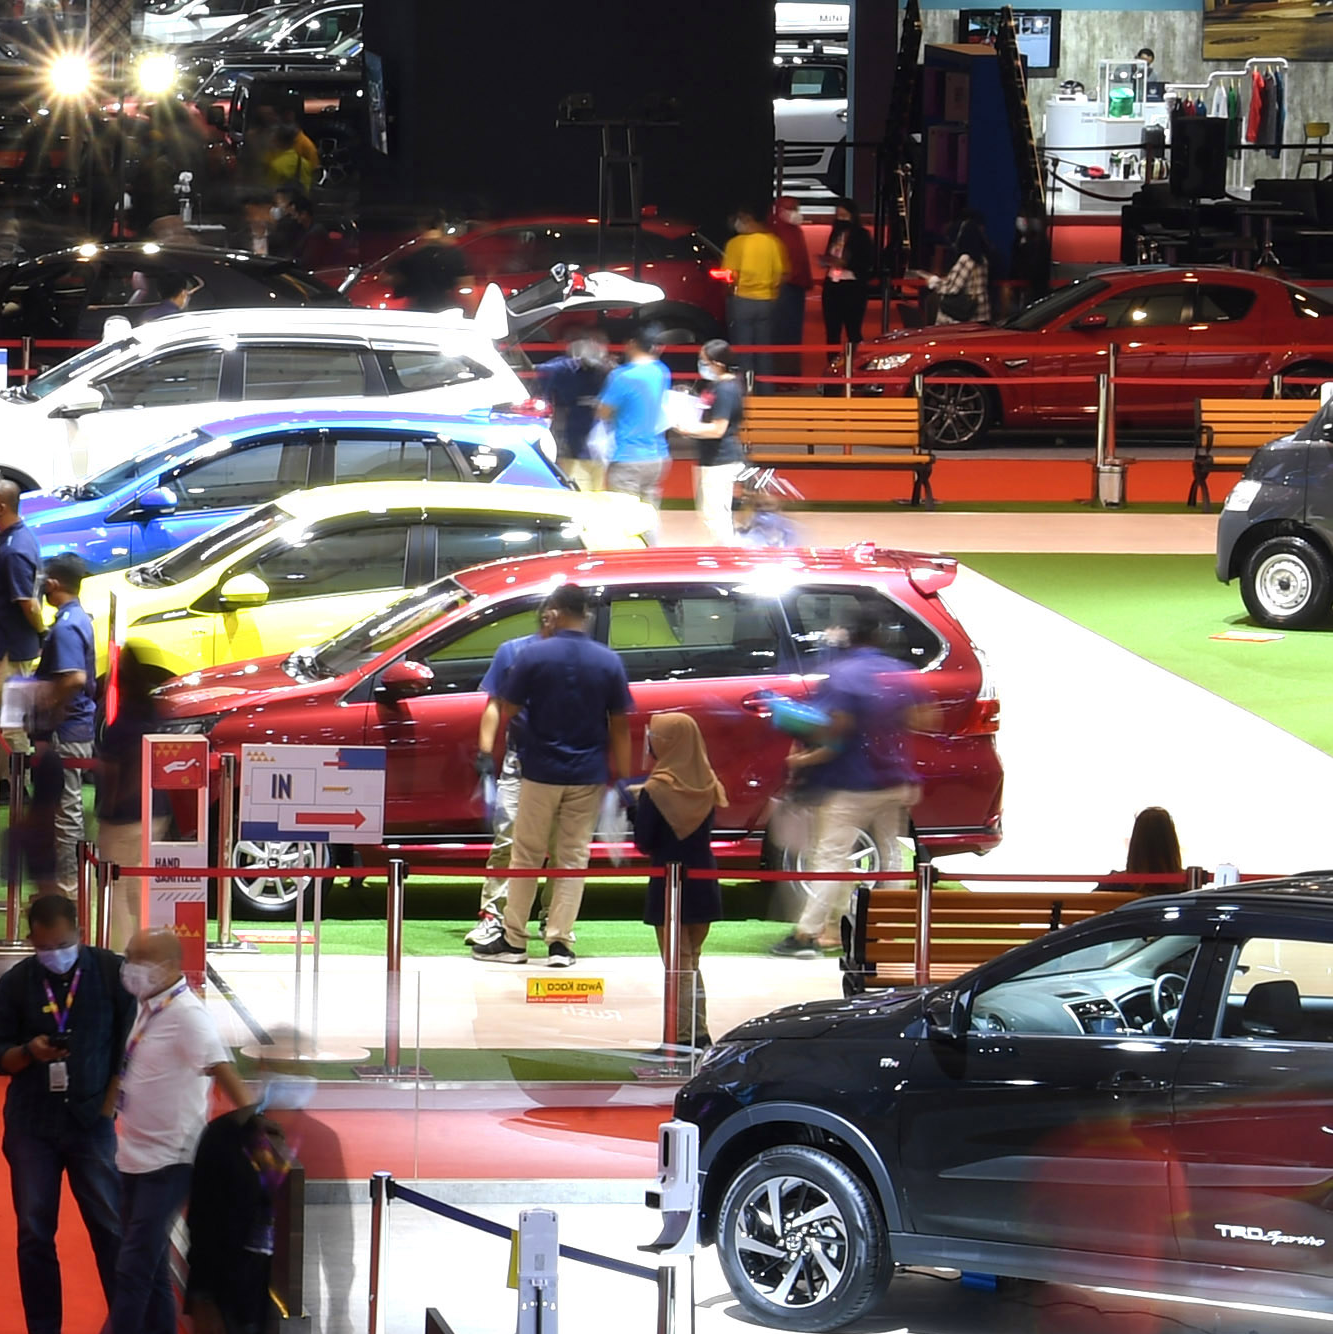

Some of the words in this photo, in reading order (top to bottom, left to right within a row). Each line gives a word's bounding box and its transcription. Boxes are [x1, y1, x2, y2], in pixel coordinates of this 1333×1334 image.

[271, 773, 293, 800] IN
[154, 857, 181, 868] HAND
[1214, 1223, 1264, 1241] TRD
